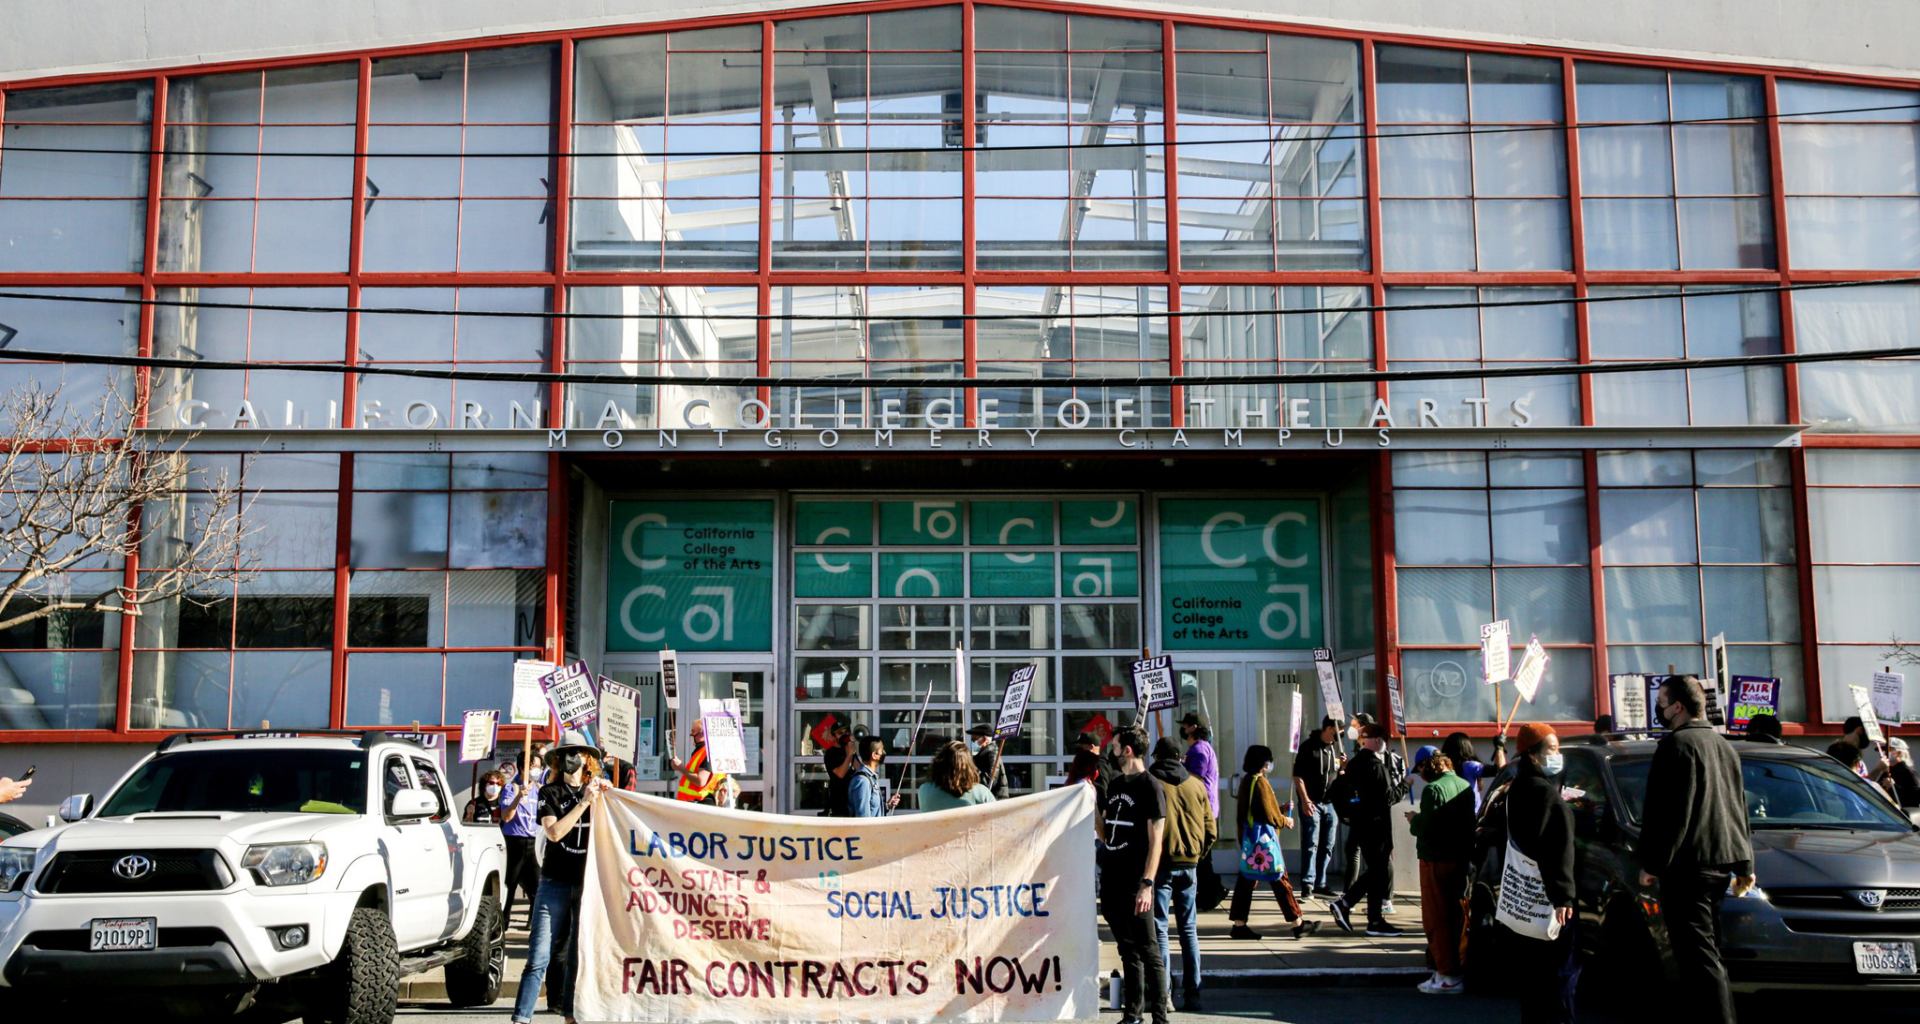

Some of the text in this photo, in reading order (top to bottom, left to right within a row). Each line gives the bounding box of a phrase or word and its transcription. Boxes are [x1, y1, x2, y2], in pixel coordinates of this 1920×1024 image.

[180, 399, 1532, 429] CALIFORNIA COLLEGE OF THE ARTS
[547, 430, 1391, 450] MONTGOMERY CAMPUS
[684, 528, 755, 540] California
[684, 543, 736, 557] College
[684, 558, 761, 570] of the Arts
[1172, 598, 1242, 610] California
[1172, 612, 1224, 627] College
[1172, 627, 1249, 640] of the Arts
[1314, 650, 1329, 660] SEIU
[1133, 656, 1167, 673] SEIU
[544, 662, 581, 689] SEIU
[635, 676, 654, 686] 1111
[1009, 665, 1034, 685] SEIU
[1141, 671, 1163, 680] UNFAIR
[1277, 674, 1297, 684] 1111
[1437, 672, 1460, 686] A2
[555, 680, 580, 694] UNFAIR
[559, 687, 583, 701] LABOR
[1009, 684, 1025, 695] UNFAIR
[1743, 683, 1769, 694] FAIR
[558, 691, 589, 709] PRACTICE
[1008, 693, 1022, 703] LABOR
[1151, 690, 1172, 701] STRIKE
[560, 709, 572, 721] ON
[573, 699, 597, 716] STRIKE
[1004, 700, 1022, 711] PRACTICE
[1735, 703, 1774, 719] NOW
[711, 717, 738, 729] STRIKE
[998, 713, 1020, 726] ON STRIKE
[715, 758, 724, 772] 2
[629, 829, 864, 862] LABOR JUSTICE
[626, 866, 772, 894] CCA STAFF &
[1524, 880, 1539, 891] New
[1519, 886, 1545, 899] Chicago
[626, 891, 751, 919] ADJUNCTS
[827, 882, 1050, 920] SOCIAL JUSTICE
[1519, 899, 1535, 911] City
[1507, 908, 1531, 923] Angeles
[1514, 905, 1550, 919] Vancouver
[104, 920, 145, 929] California
[673, 918, 771, 942] DESERVE
[94, 929, 152, 947] 91019P1
[621, 955, 1063, 999] FAIR CONTRACTS NOW!
